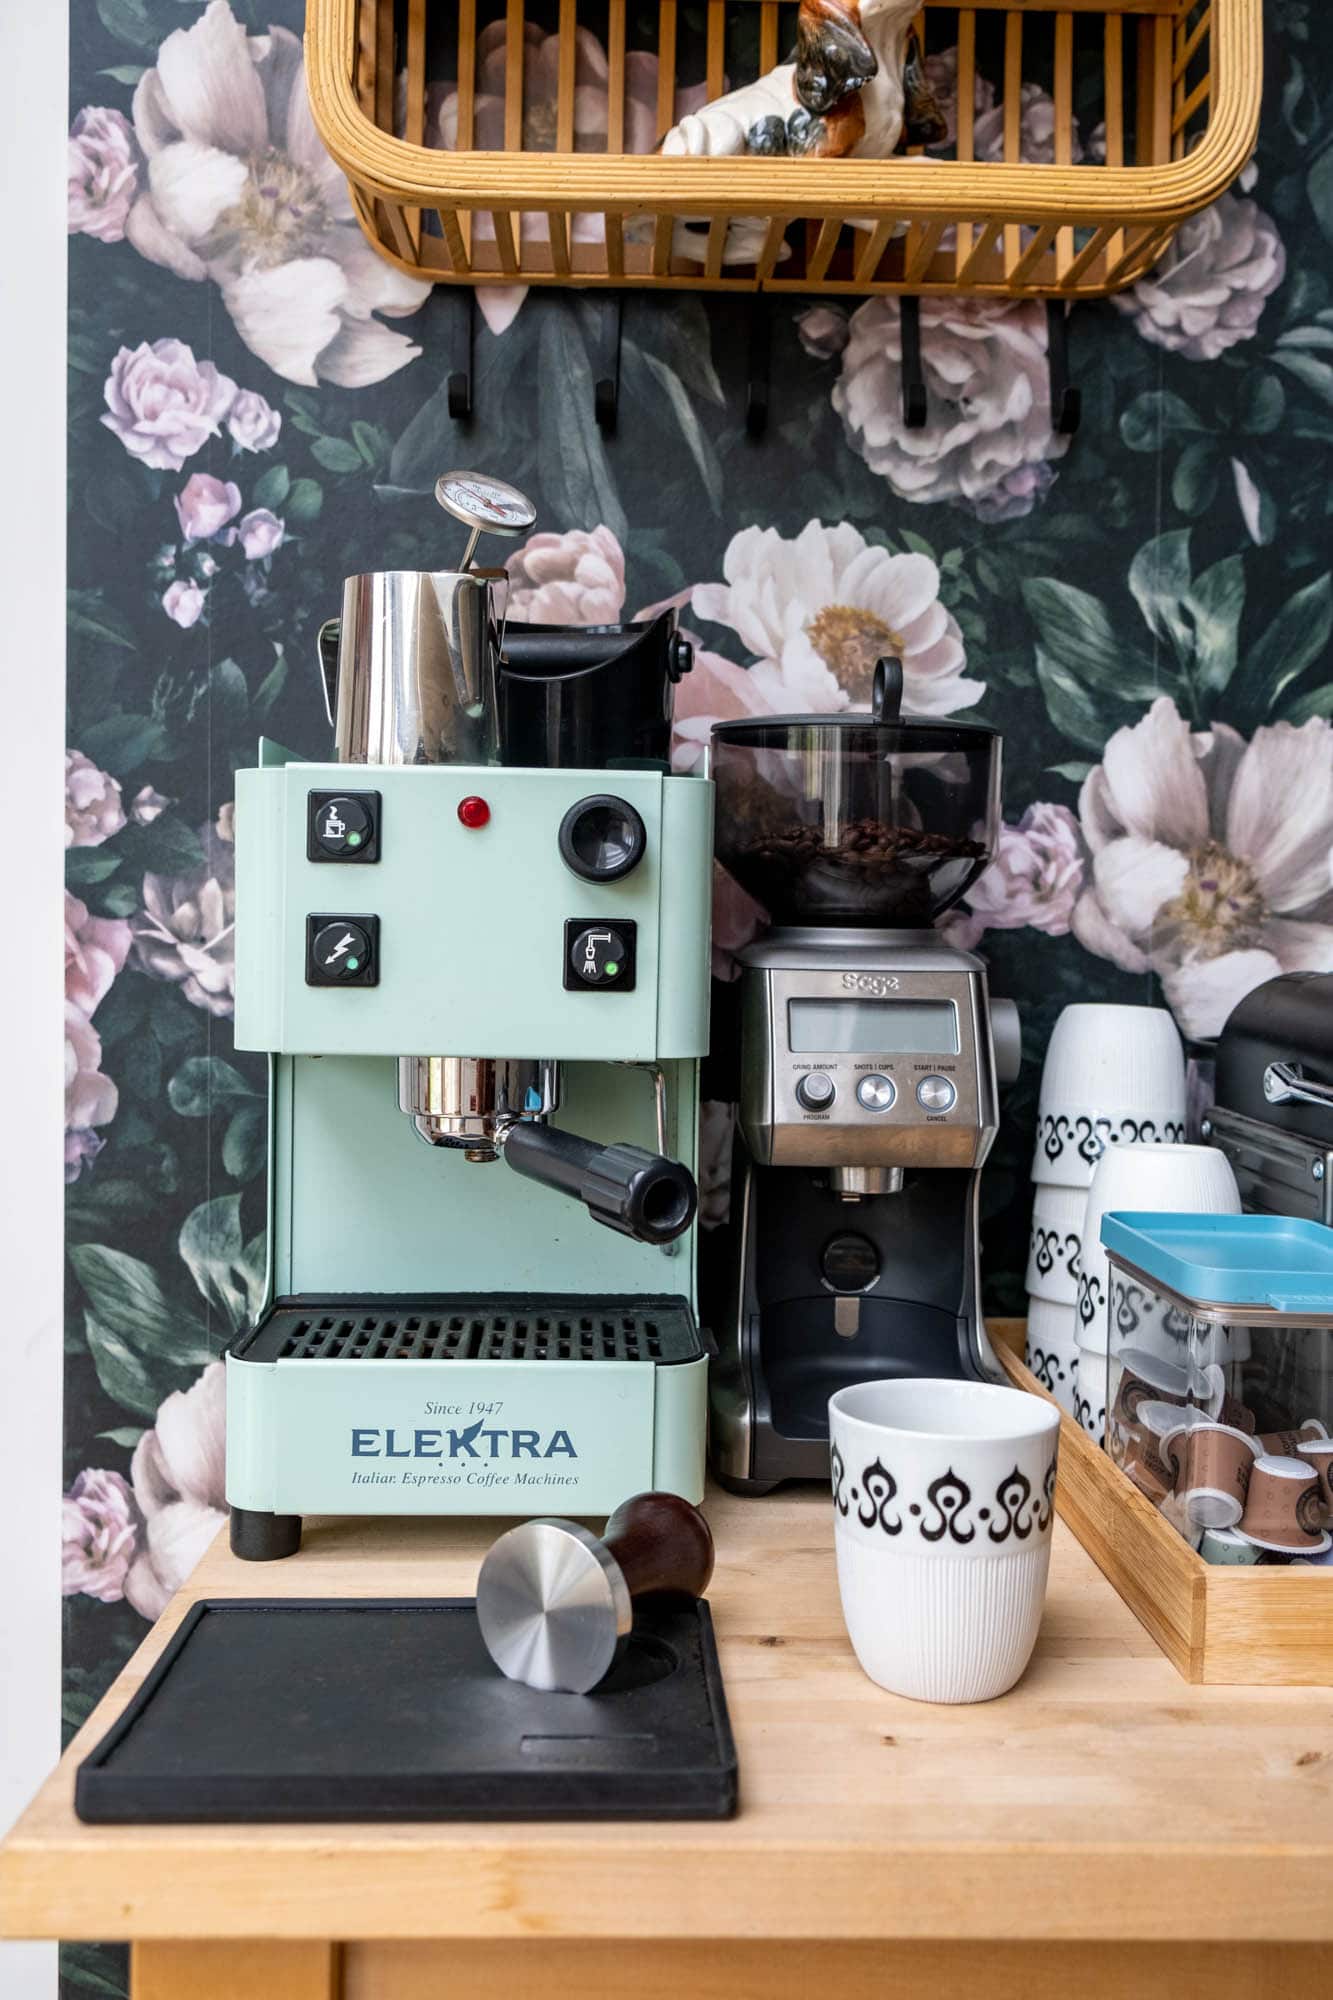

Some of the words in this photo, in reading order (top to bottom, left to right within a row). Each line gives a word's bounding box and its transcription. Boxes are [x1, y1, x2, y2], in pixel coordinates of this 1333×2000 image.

[812, 1063, 838, 1071] AMOUNT
[854, 1063, 873, 1071] SHOTS
[878, 1063, 894, 1071] CUPS
[803, 1113, 830, 1121] PROGRAM
[424, 1401, 462, 1415] Since
[468, 1401, 504, 1415] 1947
[351, 1418, 579, 1458] ELEKTRA
[402, 1471, 462, 1488] Espresso
[466, 1471, 510, 1488] Coffee
[514, 1472, 579, 1485] Machines
